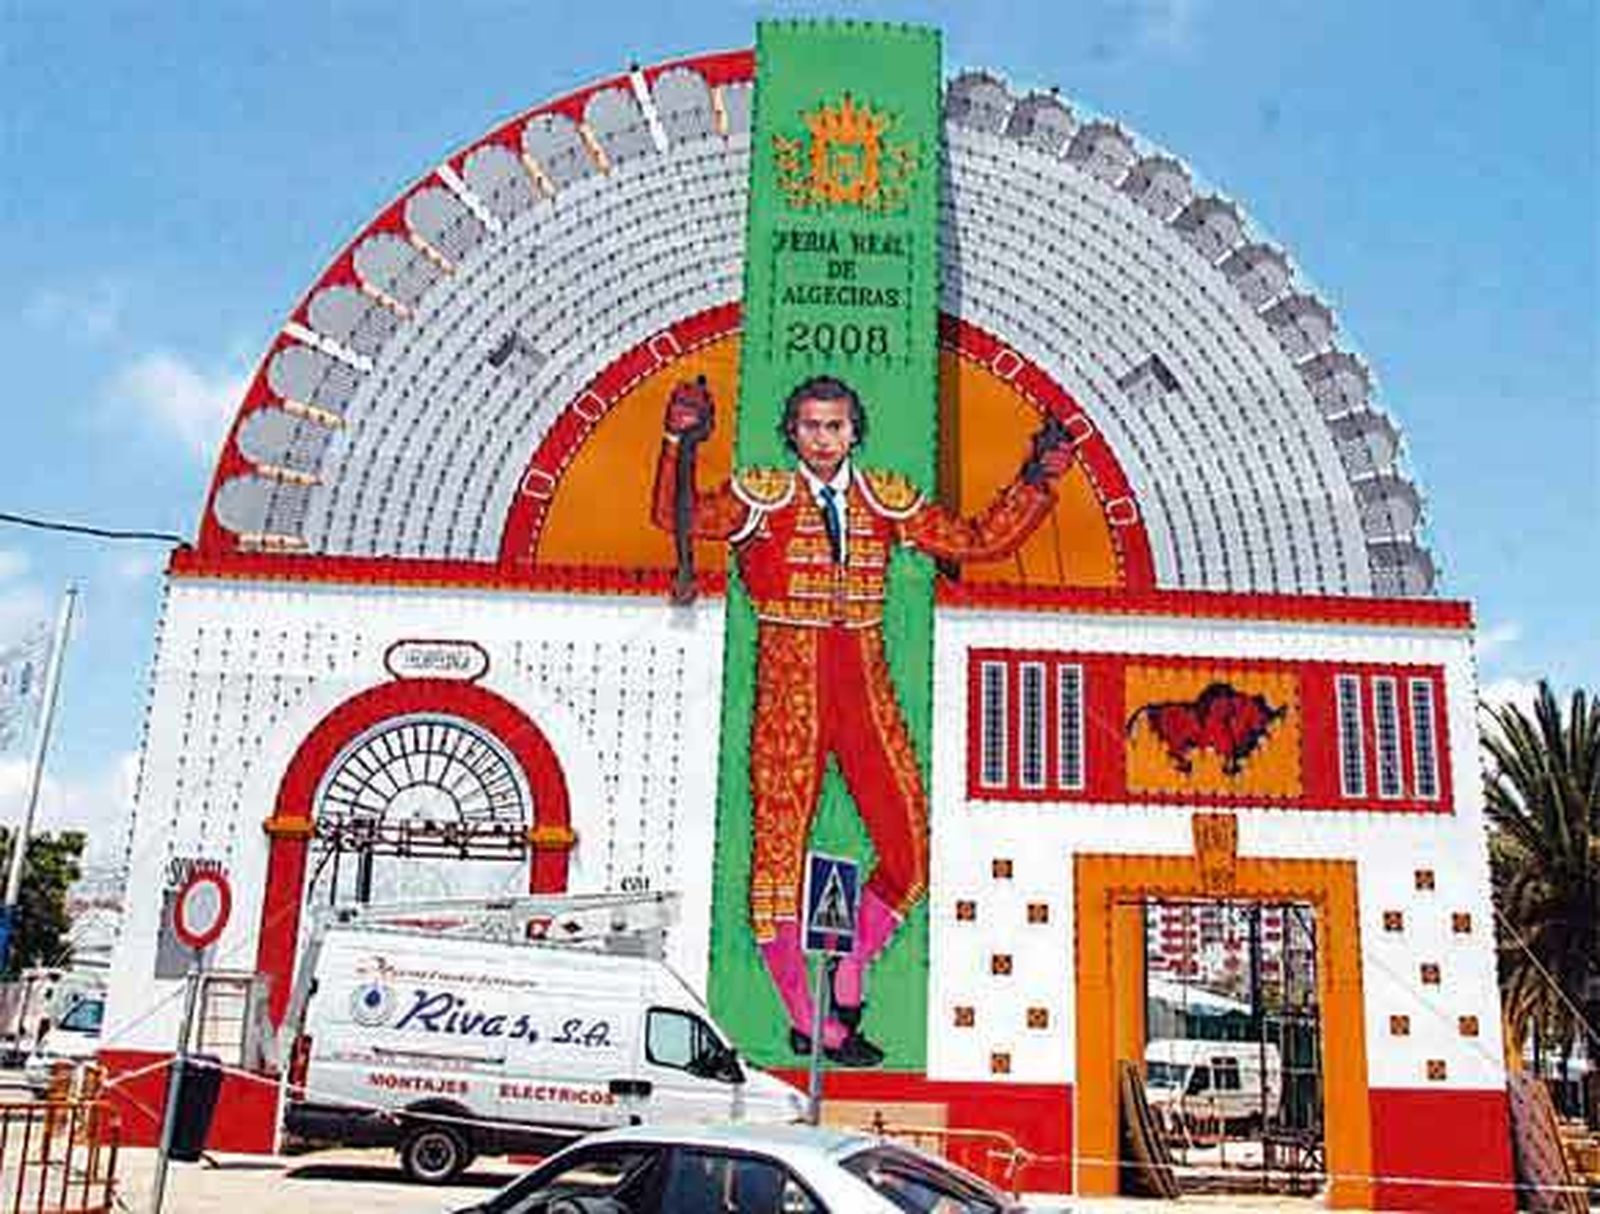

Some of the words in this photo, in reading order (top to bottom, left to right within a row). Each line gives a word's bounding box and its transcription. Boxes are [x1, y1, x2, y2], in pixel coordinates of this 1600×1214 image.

[774, 230, 839, 253] FERIA
[850, 231, 905, 256] REAL
[827, 260, 857, 280] DE
[782, 286, 901, 308] ALGECIRAS
[786, 322, 888, 356] 2008
[394, 989, 539, 1045] Rivas,
[551, 1017, 612, 1048] S.A.
[369, 1073, 469, 1094] MONTAJES
[501, 1083, 616, 1107] ELECTRICOS
